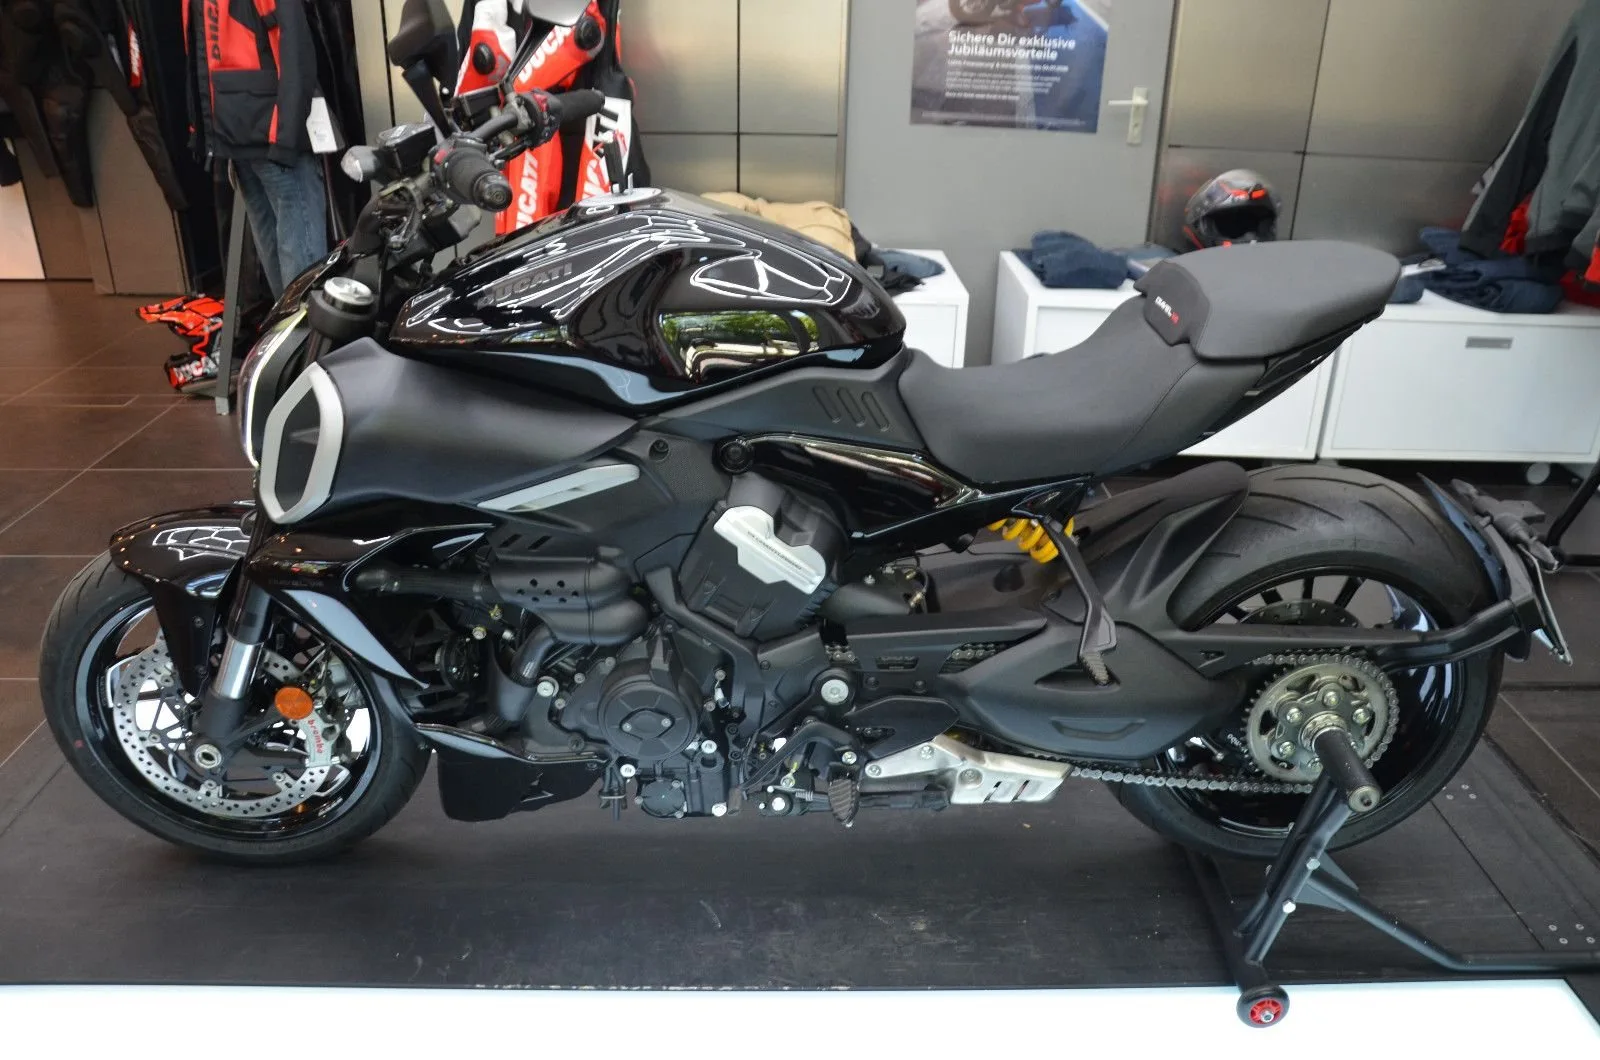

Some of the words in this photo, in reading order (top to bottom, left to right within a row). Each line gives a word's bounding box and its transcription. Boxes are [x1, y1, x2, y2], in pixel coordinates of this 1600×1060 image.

[948, 30, 995, 45] Sichere
[998, 32, 1017, 46] Dir
[1019, 34, 1076, 50] exklusive
[948, 43, 1059, 61] Jubiläumsvorteile
[516, 150, 538, 230] UCATI
[477, 263, 573, 310] DUCATI
[308, 720, 323, 753] brembo
